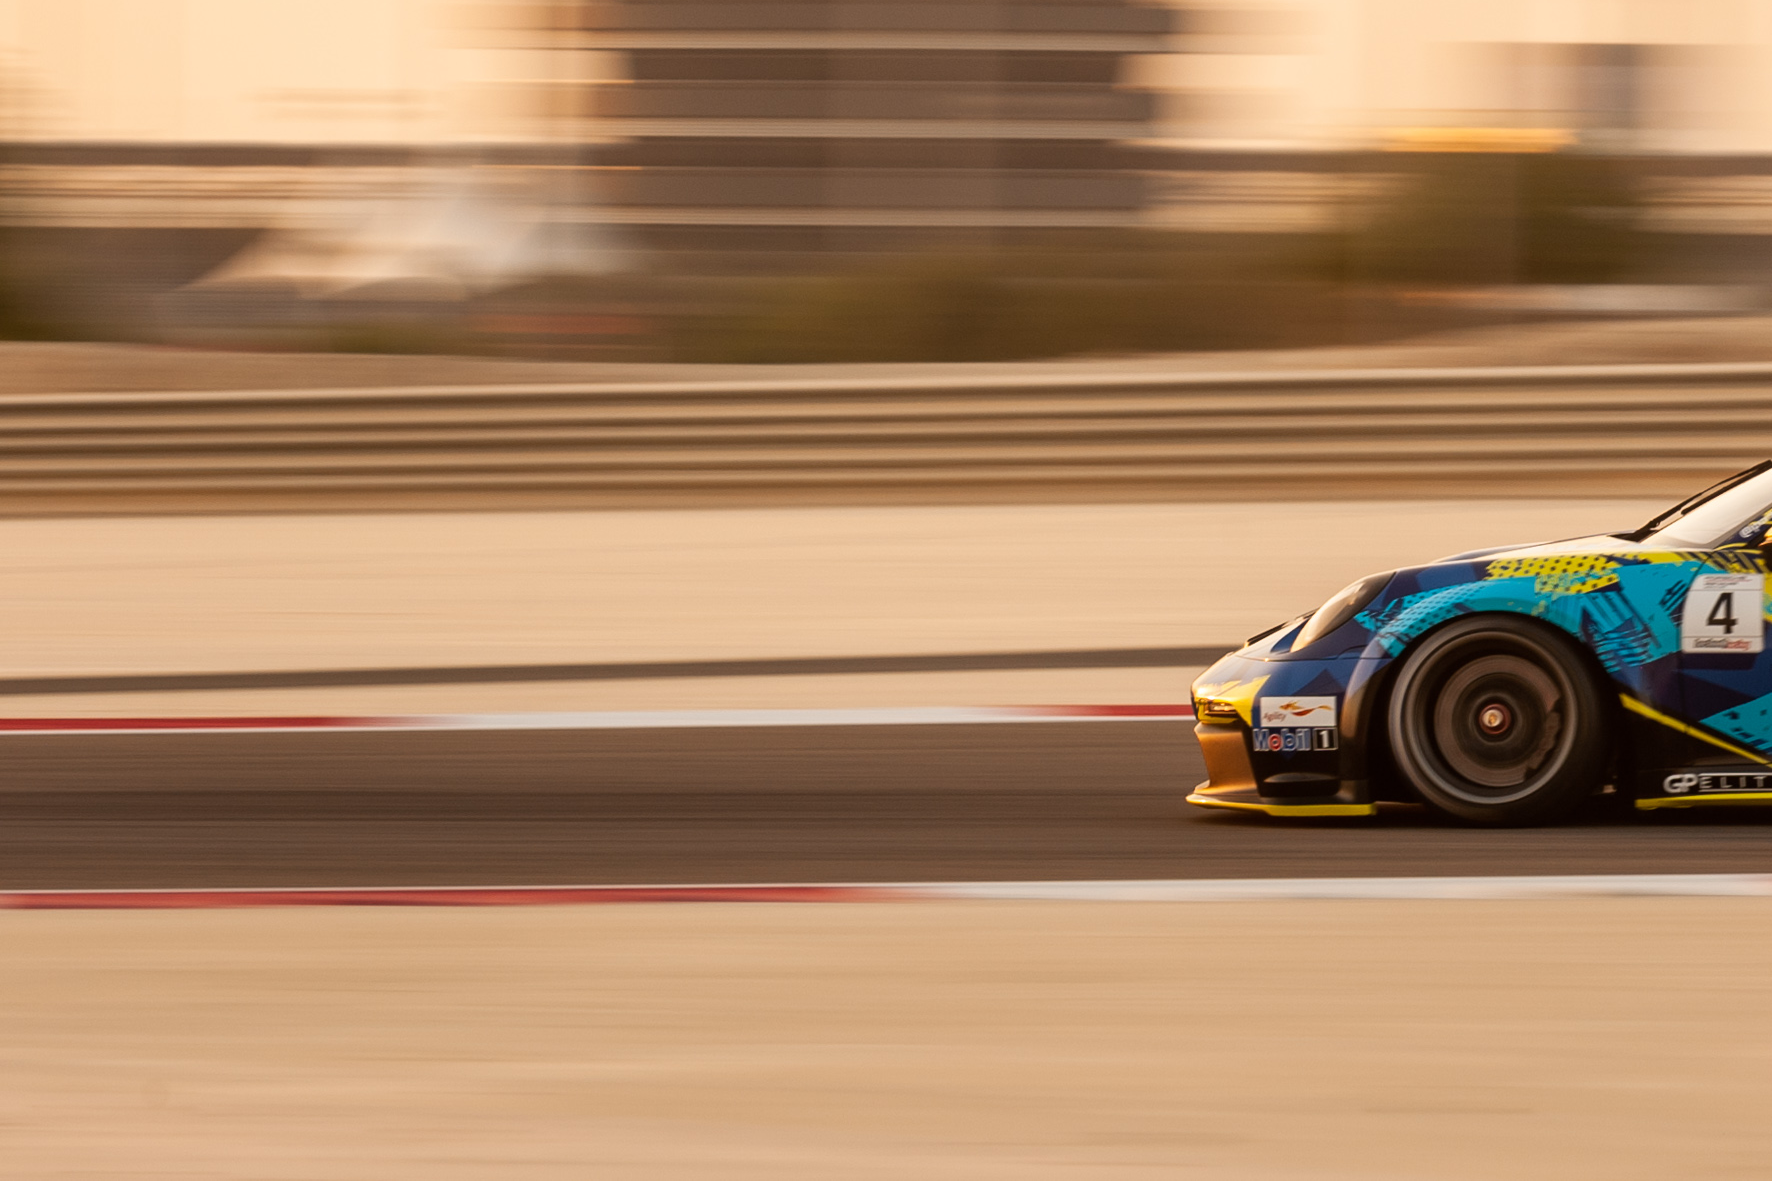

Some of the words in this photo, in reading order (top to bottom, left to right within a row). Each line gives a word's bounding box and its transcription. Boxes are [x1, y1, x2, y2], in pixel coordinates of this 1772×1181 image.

[1706, 592, 1739, 635] 4
[1252, 728, 1312, 752] Mobil
[1319, 730, 1330, 749] 1
